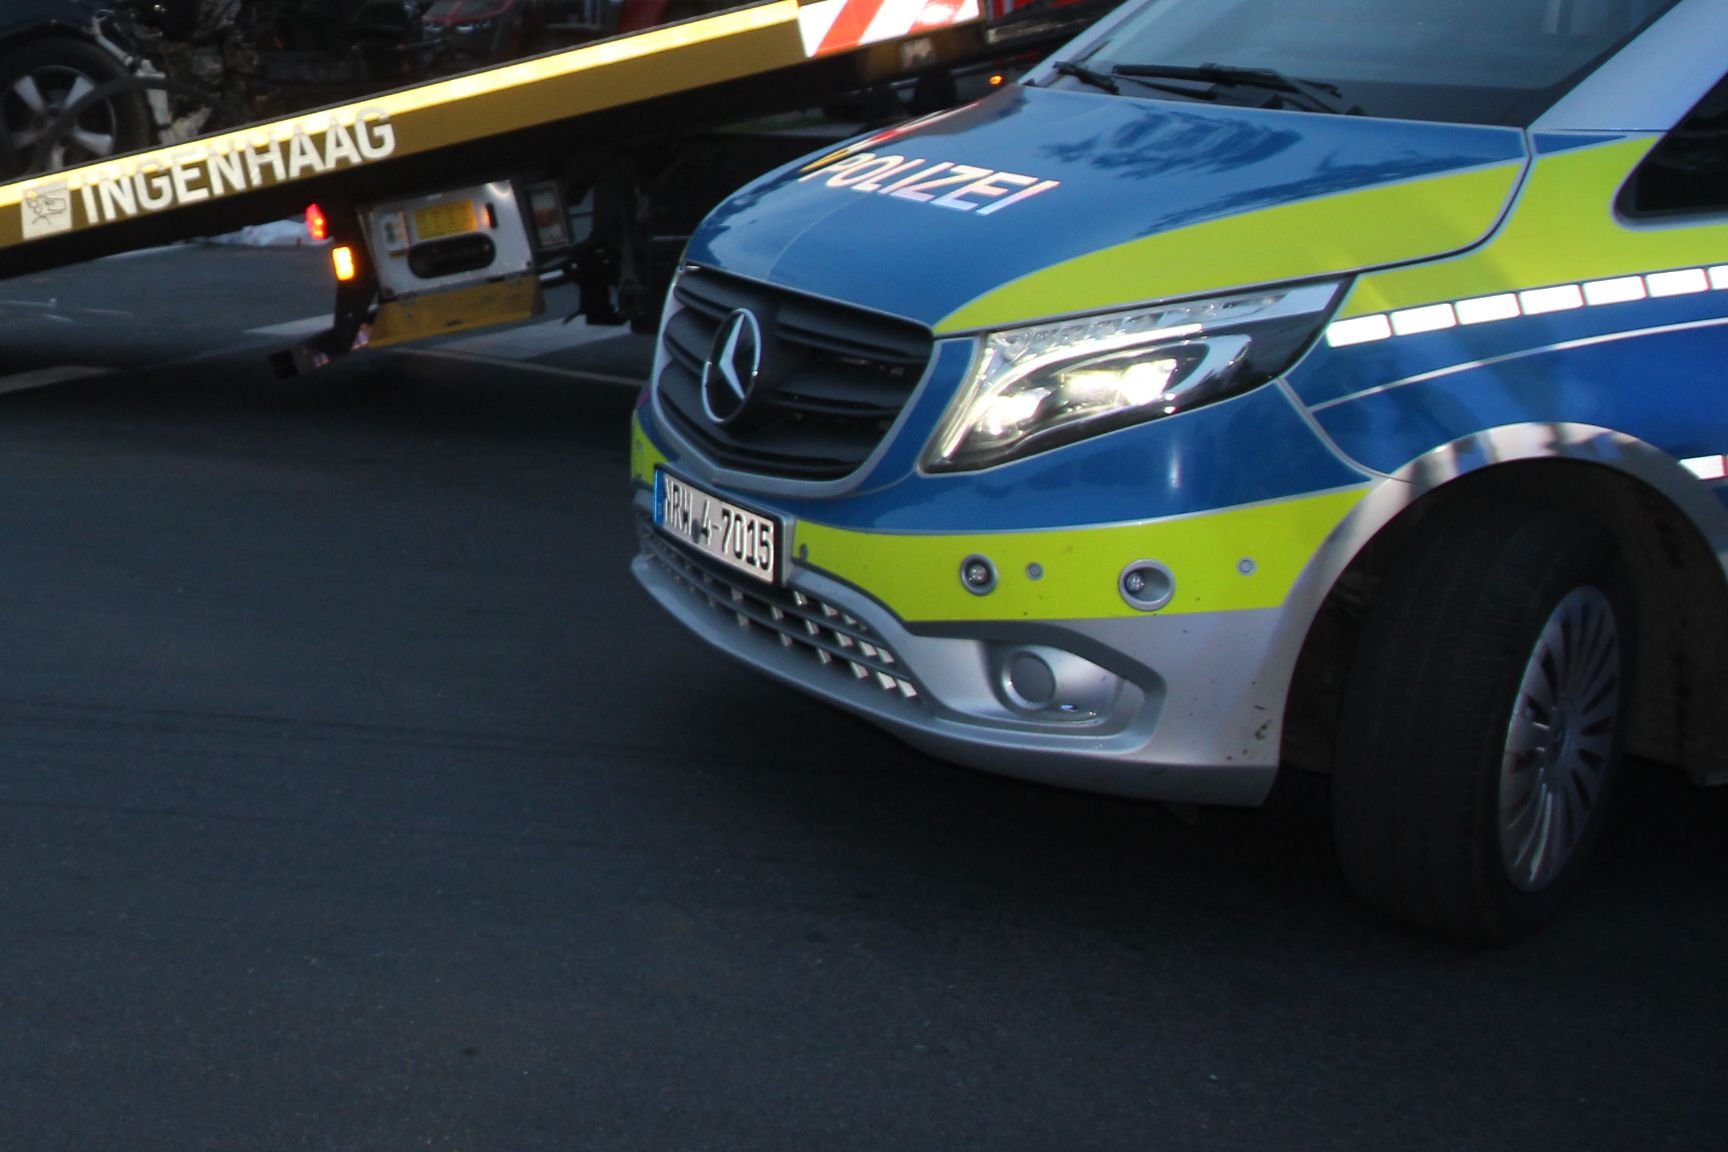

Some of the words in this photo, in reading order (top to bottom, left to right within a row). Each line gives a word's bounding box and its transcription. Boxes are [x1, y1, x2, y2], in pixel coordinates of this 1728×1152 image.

[79, 106, 396, 225] INGENHAAG
[798, 152, 1061, 215] POLIZEI
[664, 476, 693, 536] NRW
[700, 498, 774, 572] 4-7015
